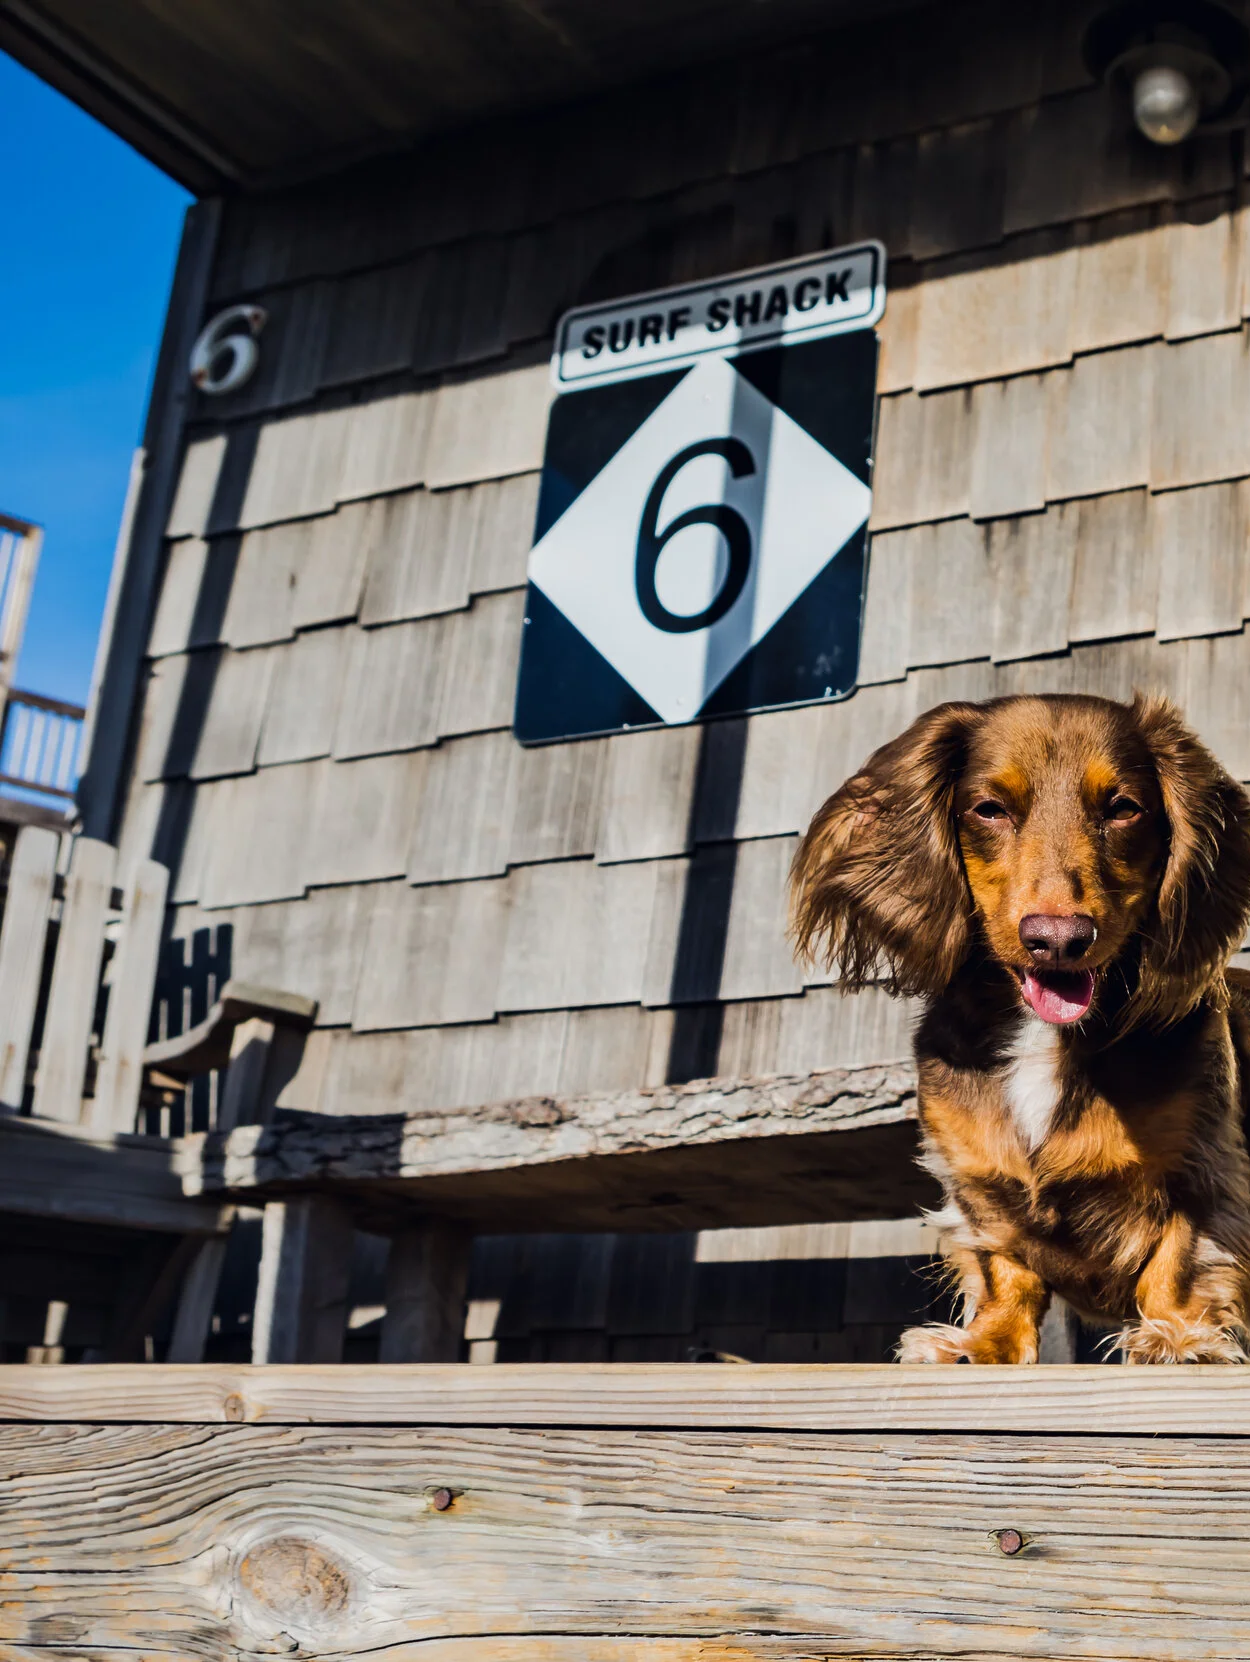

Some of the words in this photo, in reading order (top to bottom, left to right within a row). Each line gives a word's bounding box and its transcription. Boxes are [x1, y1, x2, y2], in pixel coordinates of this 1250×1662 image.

[189, 304, 267, 394] 6
[581, 306, 693, 360] SURF
[706, 268, 853, 334] SHACK
[634, 436, 756, 634] 6
